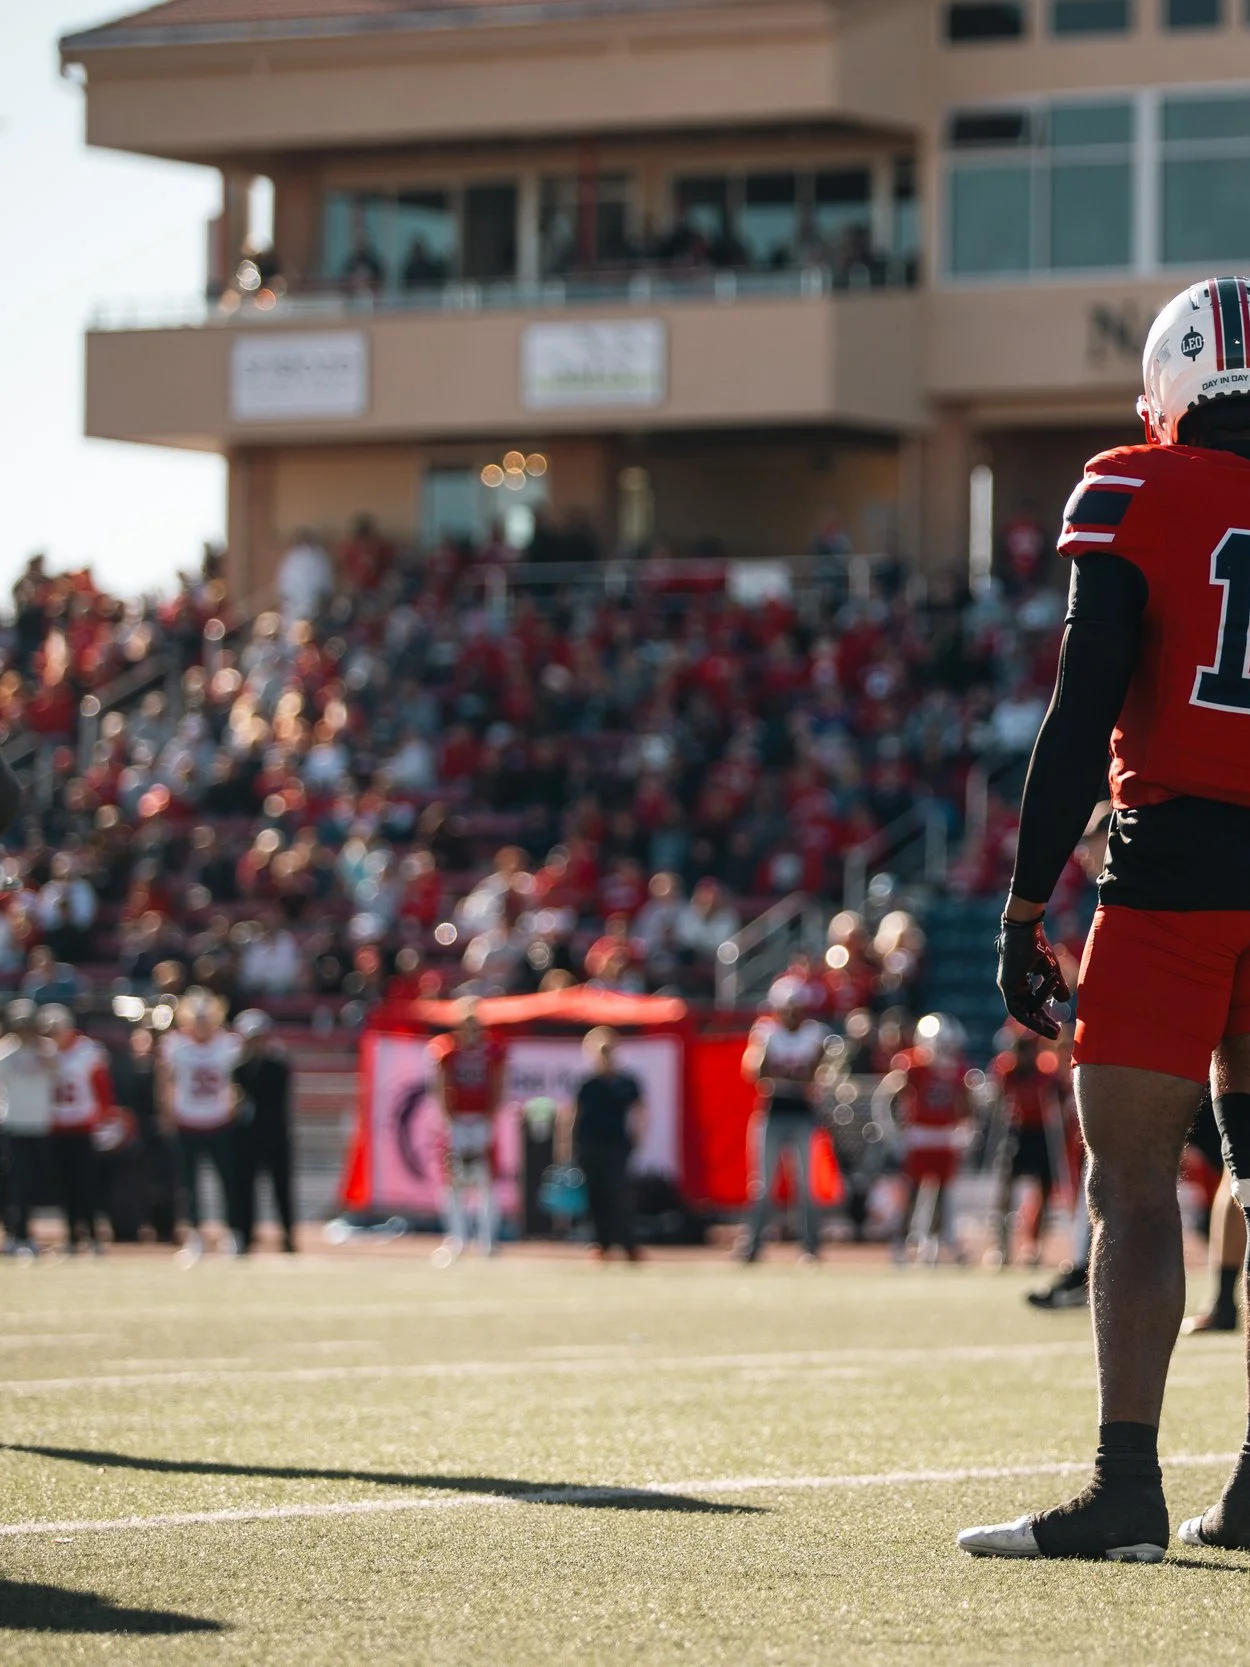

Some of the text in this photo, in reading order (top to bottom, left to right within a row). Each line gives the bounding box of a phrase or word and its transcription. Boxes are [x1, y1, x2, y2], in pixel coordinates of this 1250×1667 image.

[1182, 336, 1203, 353] LEO
[1202, 379, 1218, 391] DAY
[1220, 376, 1230, 384] IN
[1231, 375, 1249, 383] DAY
